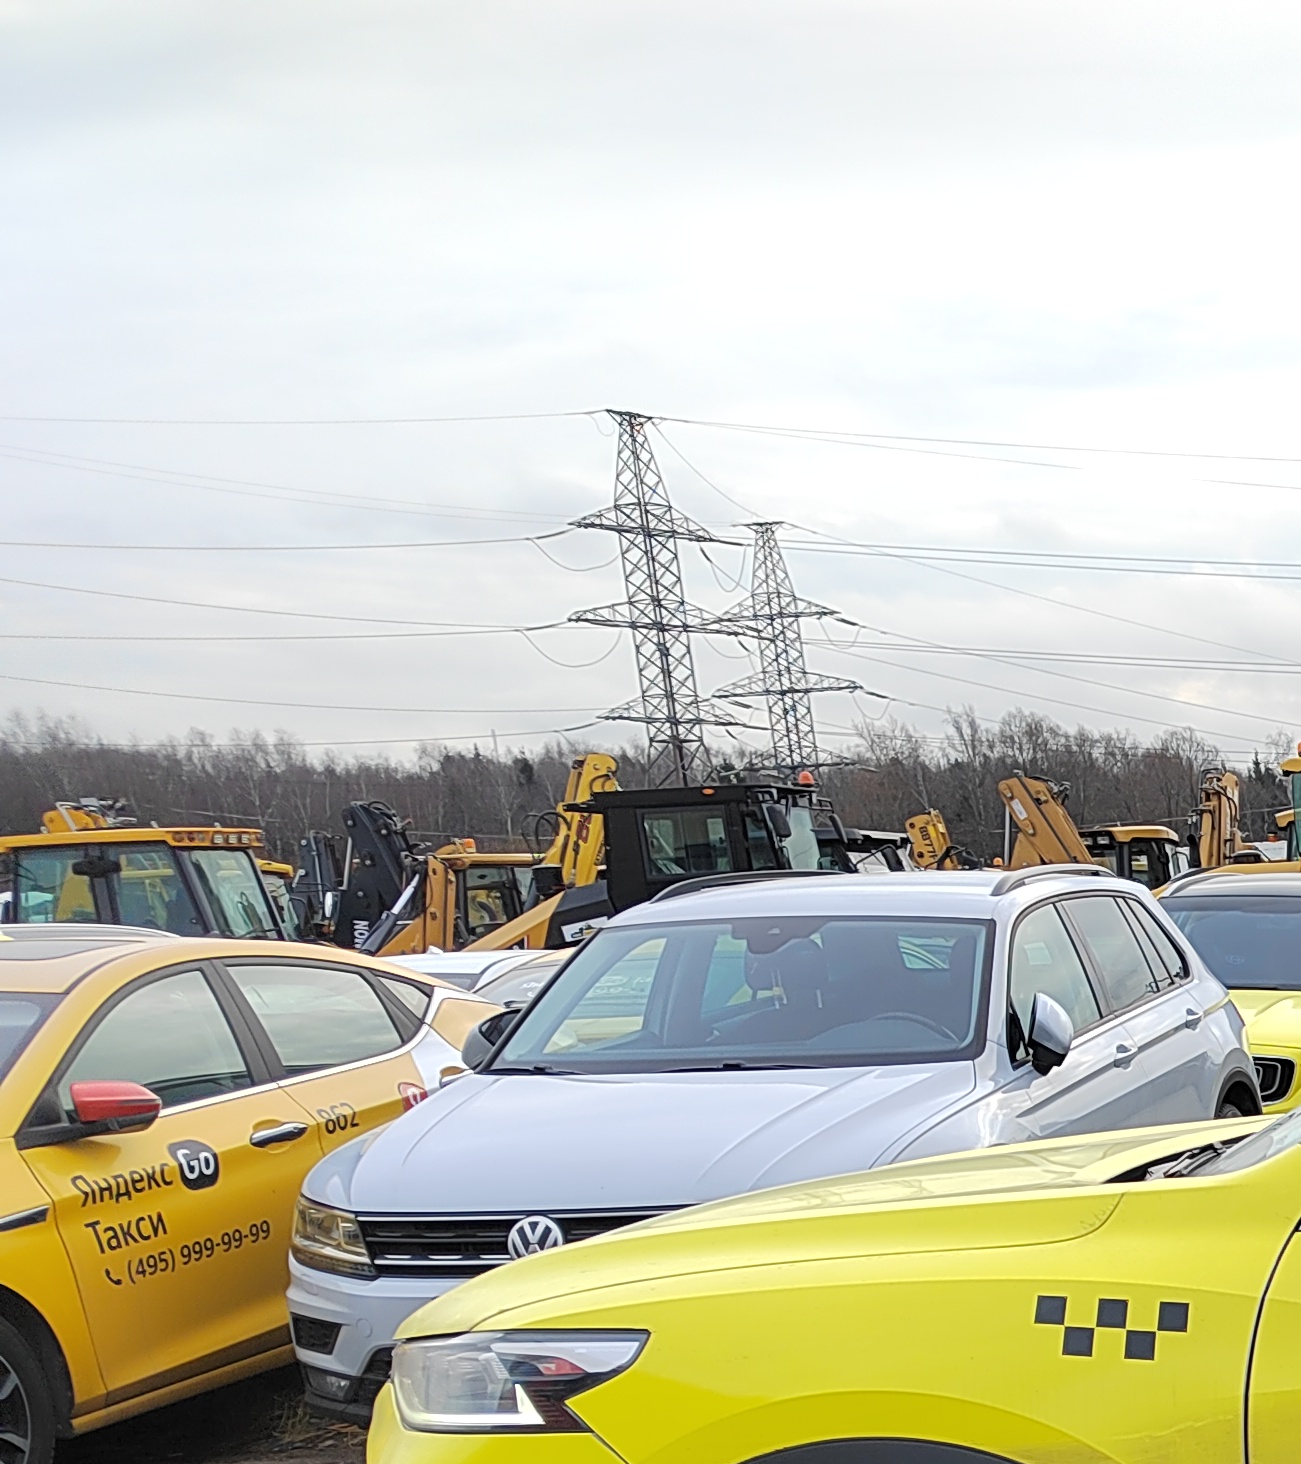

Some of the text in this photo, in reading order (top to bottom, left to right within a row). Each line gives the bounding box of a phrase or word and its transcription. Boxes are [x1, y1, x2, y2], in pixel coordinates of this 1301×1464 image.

[316, 1102, 360, 1136] 862
[70, 1146, 216, 1208] Яндекс Go
[84, 1211, 168, 1255] Такси
[127, 1219, 272, 1285] (495) 999-99-99
